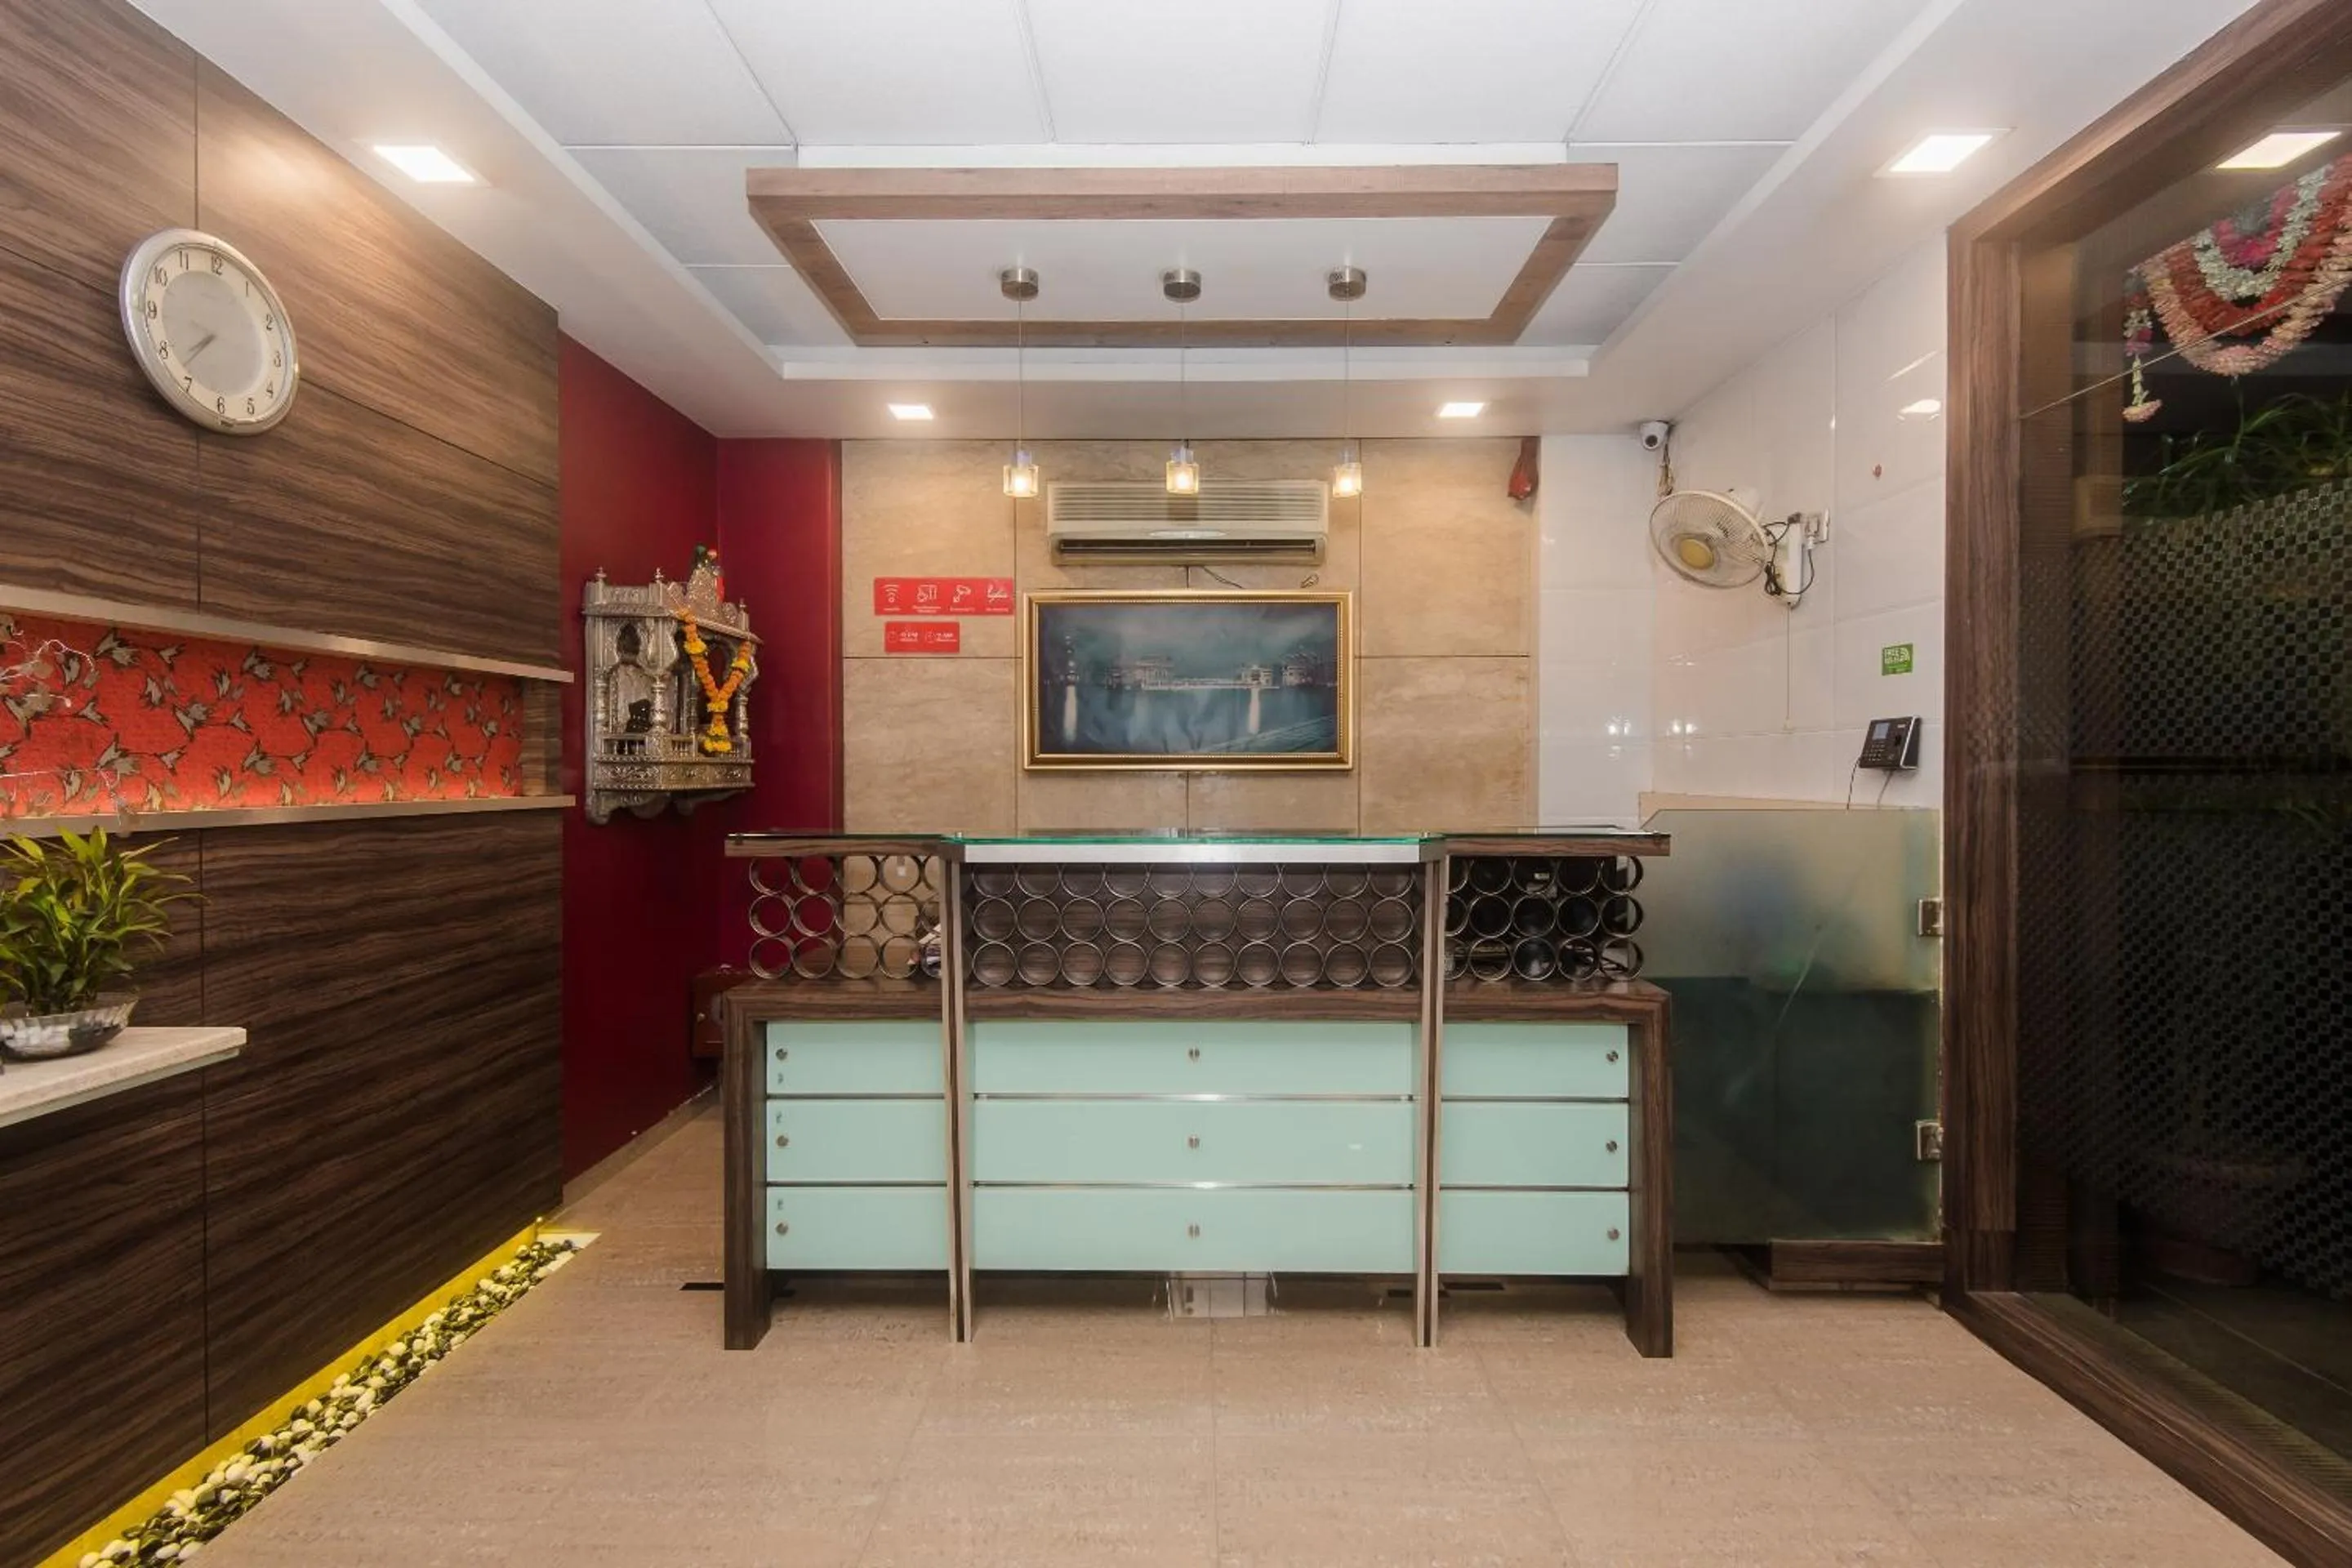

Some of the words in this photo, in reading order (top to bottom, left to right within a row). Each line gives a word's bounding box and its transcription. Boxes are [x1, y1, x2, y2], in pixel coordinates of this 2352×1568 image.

[178, 251, 189, 270] 11
[211, 254, 223, 275] 12
[154, 265, 168, 287] 10
[147, 301, 158, 320] 9
[265, 314, 274, 331] 2
[159, 340, 169, 360] 8
[274, 351, 282, 368] 3
[184, 376, 193, 394] 7
[265, 381, 274, 399] 4
[216, 396, 225, 415] 6
[247, 398, 256, 415] 5
